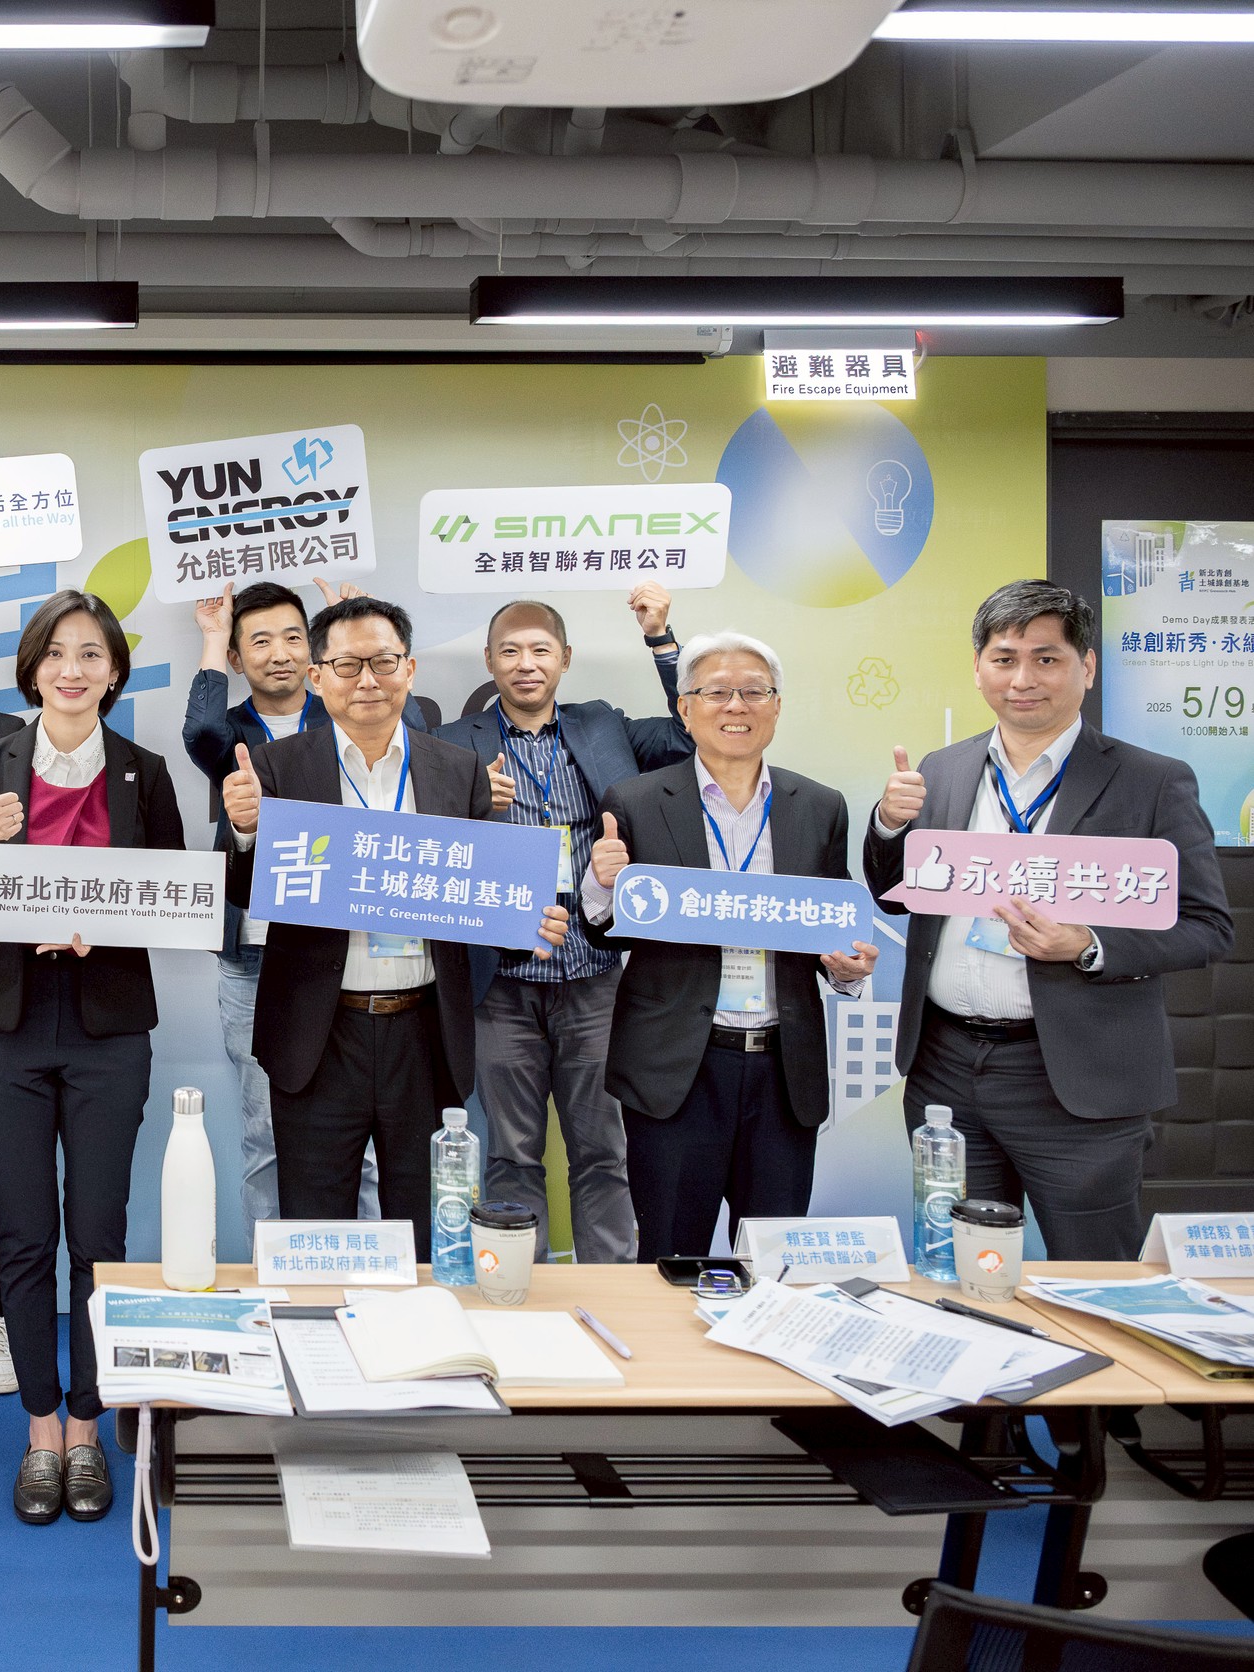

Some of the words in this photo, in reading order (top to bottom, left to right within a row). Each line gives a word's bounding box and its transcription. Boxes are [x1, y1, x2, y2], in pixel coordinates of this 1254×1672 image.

[772, 355, 907, 378] 避難器具
[772, 385, 794, 394] Fire
[799, 384, 841, 396] Escape
[846, 384, 908, 396] Equipment
[156, 458, 263, 504] YUN
[2, 515, 19, 529] all
[21, 514, 44, 527] the
[47, 512, 75, 528] Way
[167, 486, 359, 544] ENERGY
[494, 511, 721, 539] SMANEX
[176, 532, 359, 583] 允能有限公司
[1199, 569, 1232, 578] 新北青創
[1199, 579, 1249, 588] 土城綠創基地
[1162, 616, 1189, 624] Demo
[1146, 702, 1172, 713] 2025
[1183, 686, 1245, 719] 5/9
[351, 830, 475, 871] 新北青創
[959, 855, 1170, 905] 永續共好
[348, 867, 534, 912] 土城綠創基地
[0, 903, 19, 913] New
[22, 904, 49, 914] Taipei
[52, 905, 70, 916] City
[73, 907, 128, 917] Government
[131, 908, 157, 918] Youth
[159, 910, 215, 920] Department
[348, 903, 385, 917] NTPC
[389, 908, 455, 925] Greentech
[458, 915, 484, 928] Hub
[679, 887, 858, 929] 創新救地球
[786, 1231, 832, 1247] 賴荃賢
[835, 1231, 866, 1246] 總監
[1186, 1224, 1233, 1241] 賴銘毅
[289, 1233, 340, 1251] 邱兆梅
[345, 1234, 379, 1251] 局長
[781, 1249, 878, 1265] 台北市電腦公會
[1184, 1244, 1254, 1259] 漢華會計師
[272, 1255, 398, 1272] 新北市政府青年局
